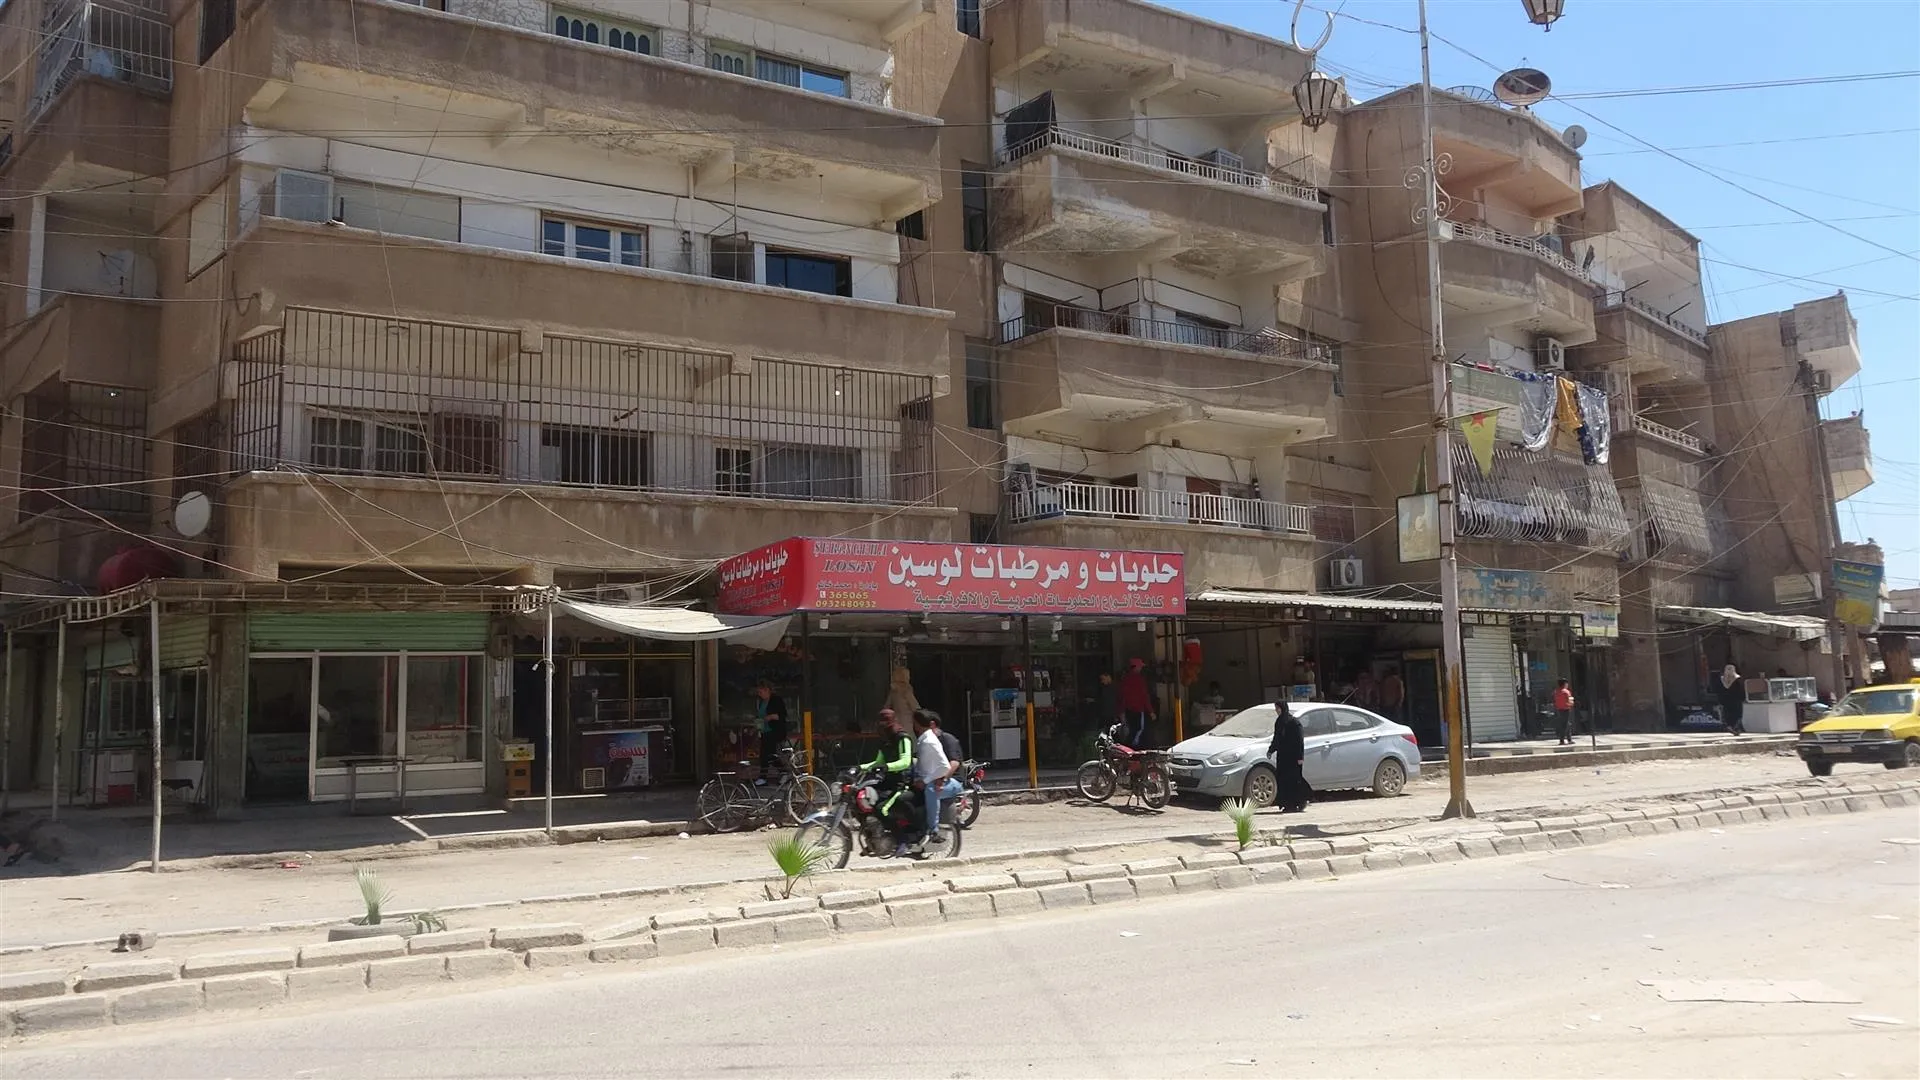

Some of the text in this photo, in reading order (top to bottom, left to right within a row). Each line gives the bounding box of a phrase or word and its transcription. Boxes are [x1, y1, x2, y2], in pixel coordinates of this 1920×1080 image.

[888, 546, 1179, 592] حلويات و مرطبات لوسين
[829, 591, 869, 599] 365065
[1132, 593, 1164, 609] كافة
[815, 600, 877, 608] 0932480932
